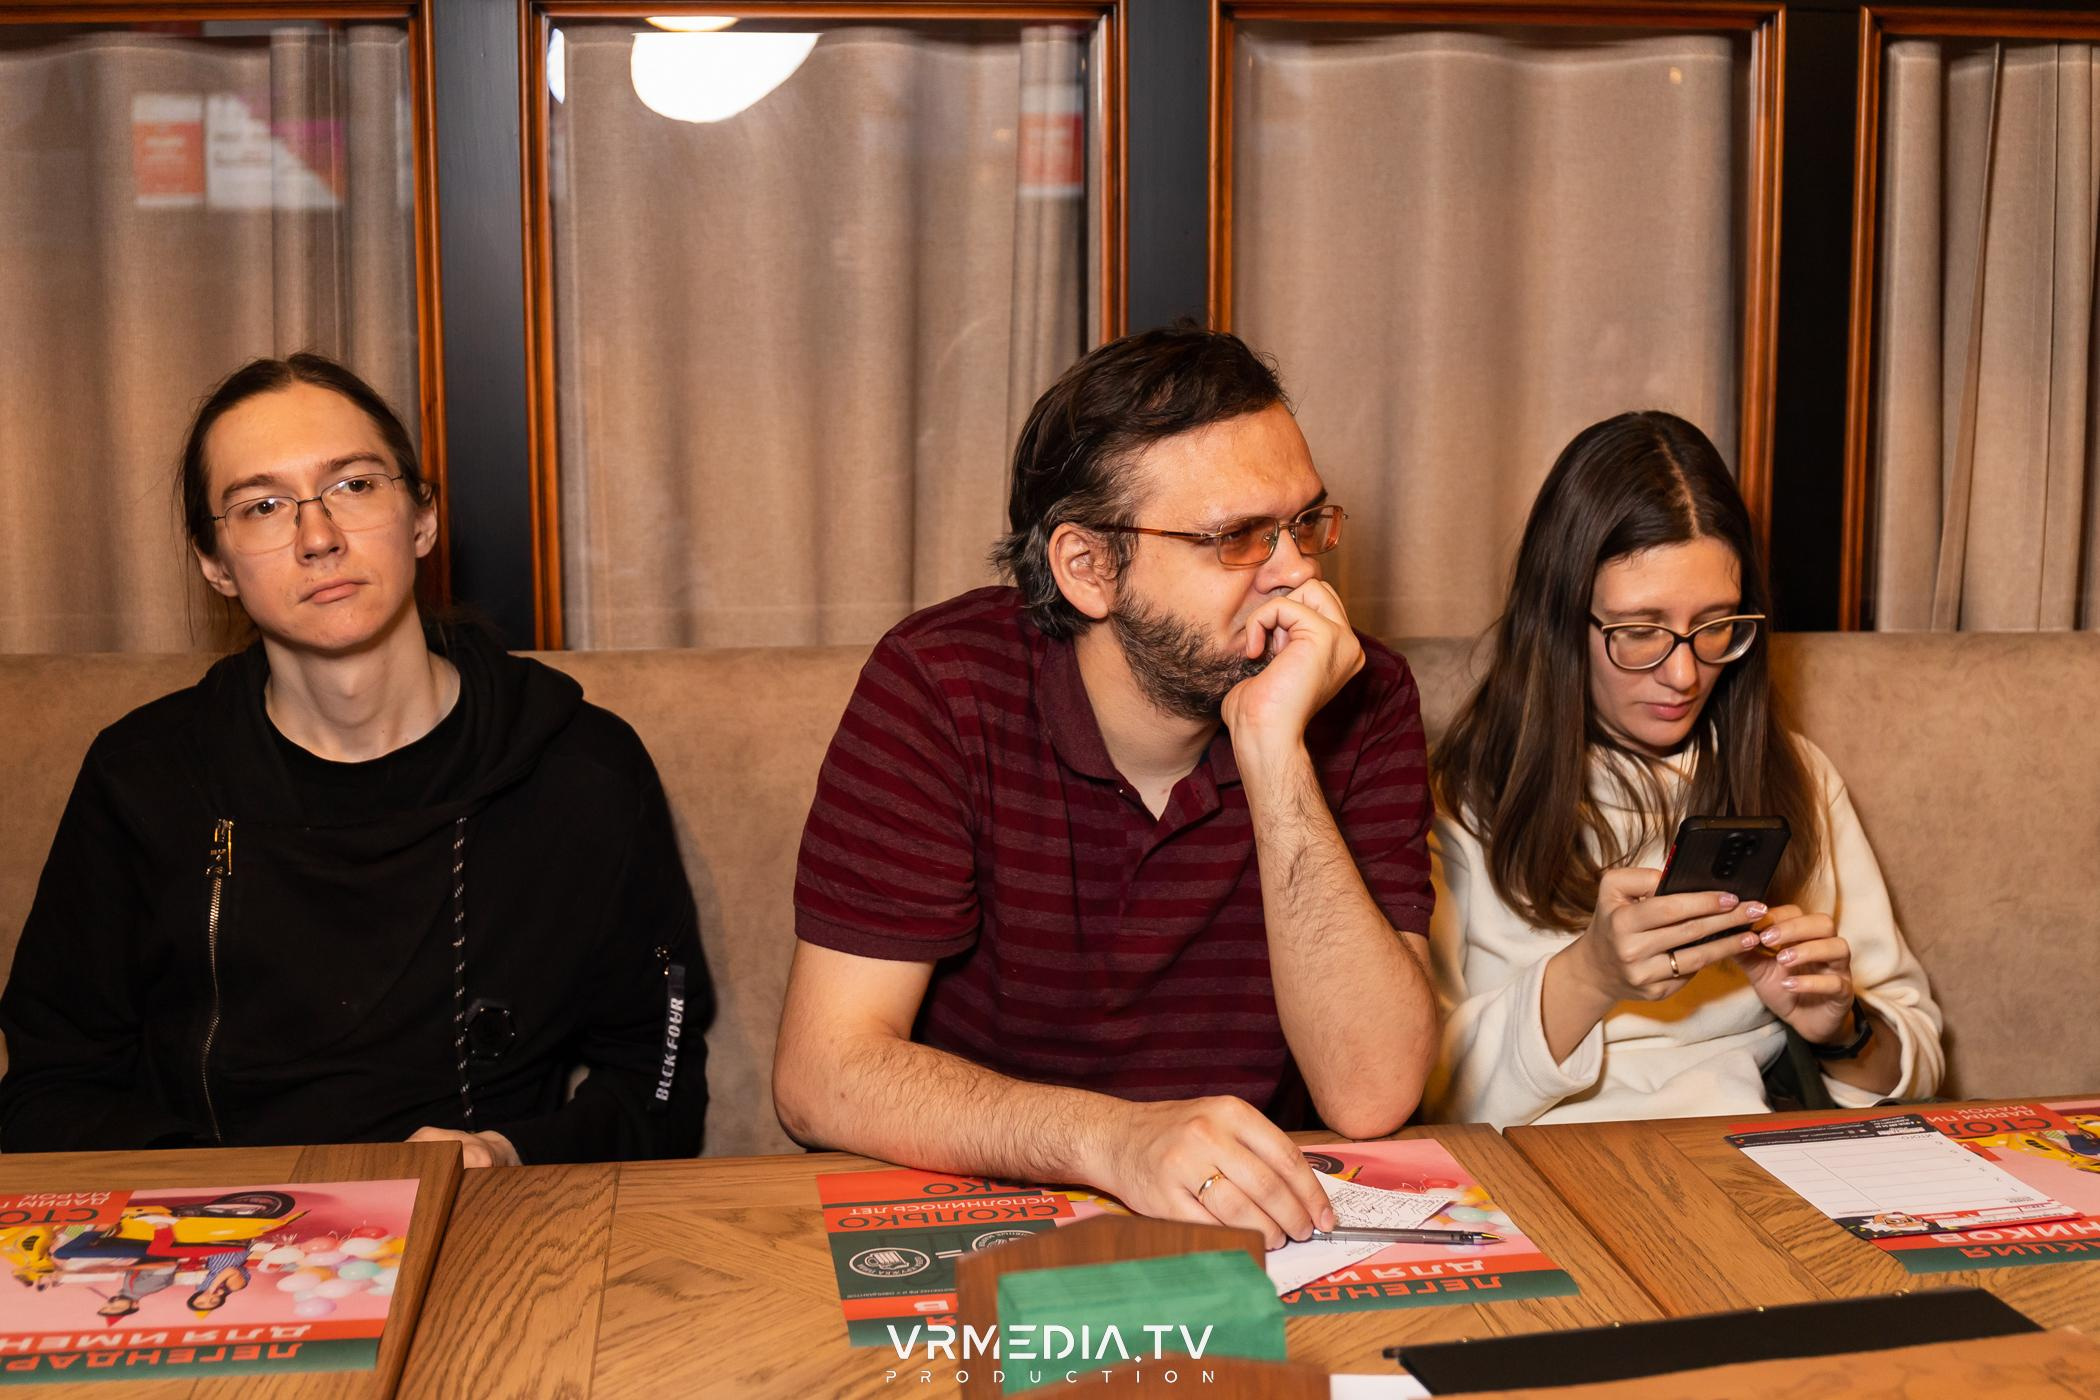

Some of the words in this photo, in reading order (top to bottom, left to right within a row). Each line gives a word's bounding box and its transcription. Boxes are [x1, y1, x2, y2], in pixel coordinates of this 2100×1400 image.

[655, 1053, 677, 1101] BLCK
[1953, 1105, 2028, 1115] МАРОК
[1961, 1109, 2037, 1121] ДАРИМ
[16, 1196, 109, 1208] ДАРИМ
[23, 1191, 111, 1200] МАРОК
[849, 1207, 888, 1215] ЛЕТ
[893, 1197, 1055, 1212] ИСПОЛНИЛОСЬ
[838, 1205, 1059, 1228] СКОЛЬКО
[1373, 1260, 1484, 1277] ДЛЯ
[182, 1325, 311, 1341] ДЛЯ
